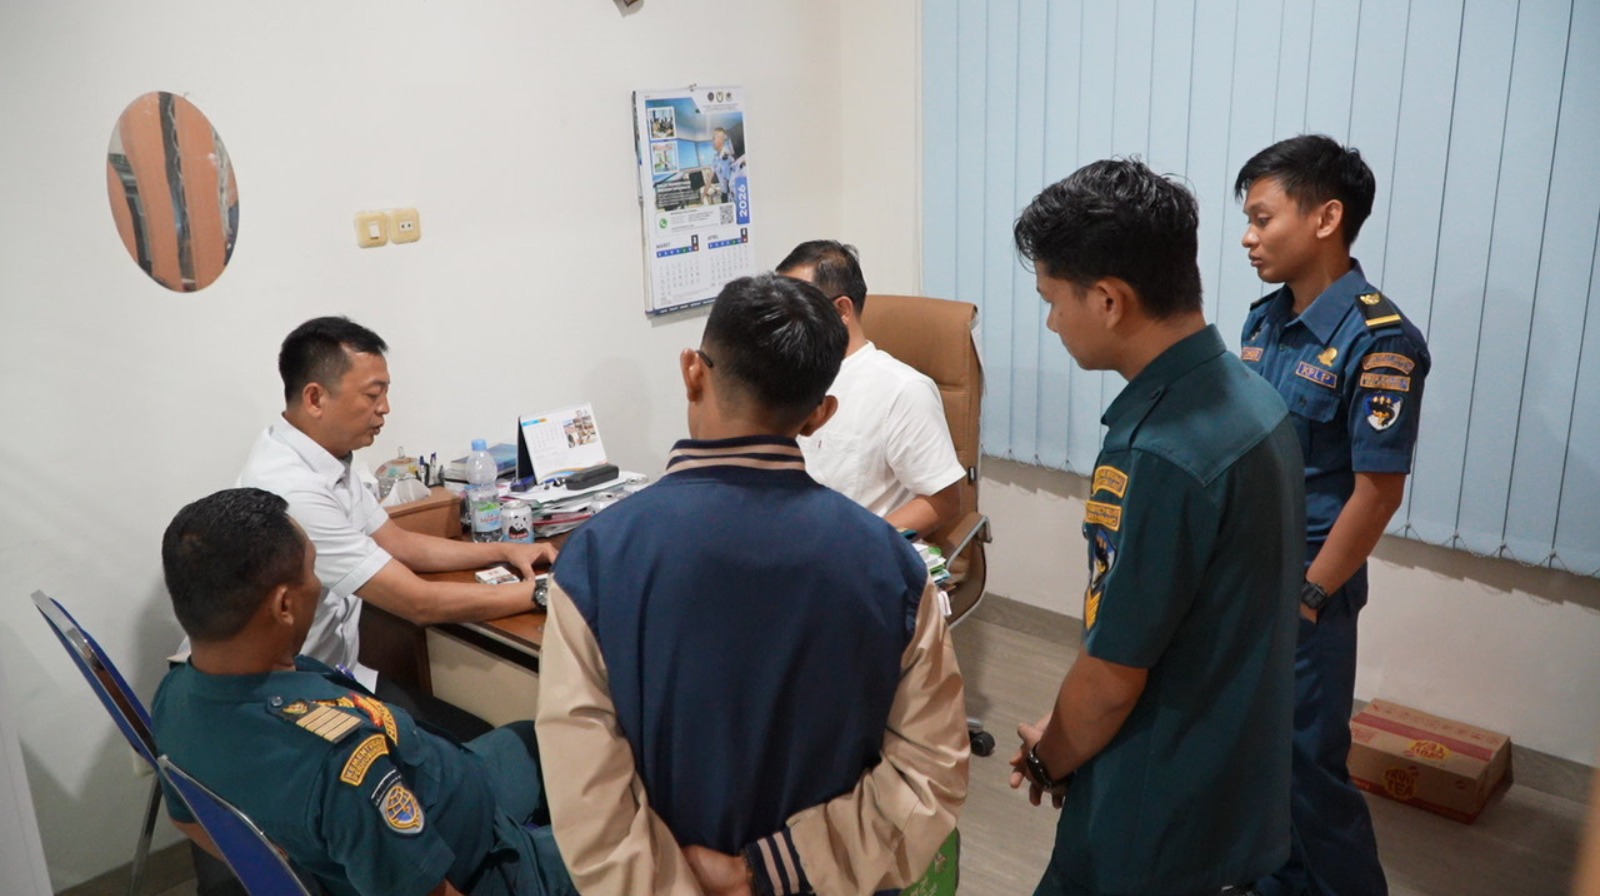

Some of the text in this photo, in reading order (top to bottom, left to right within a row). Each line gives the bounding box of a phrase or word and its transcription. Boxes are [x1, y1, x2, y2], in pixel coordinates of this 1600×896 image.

[738, 184, 748, 217] 2026
[1302, 365, 1331, 382] KPLP
[1387, 779, 1414, 797] TEA
